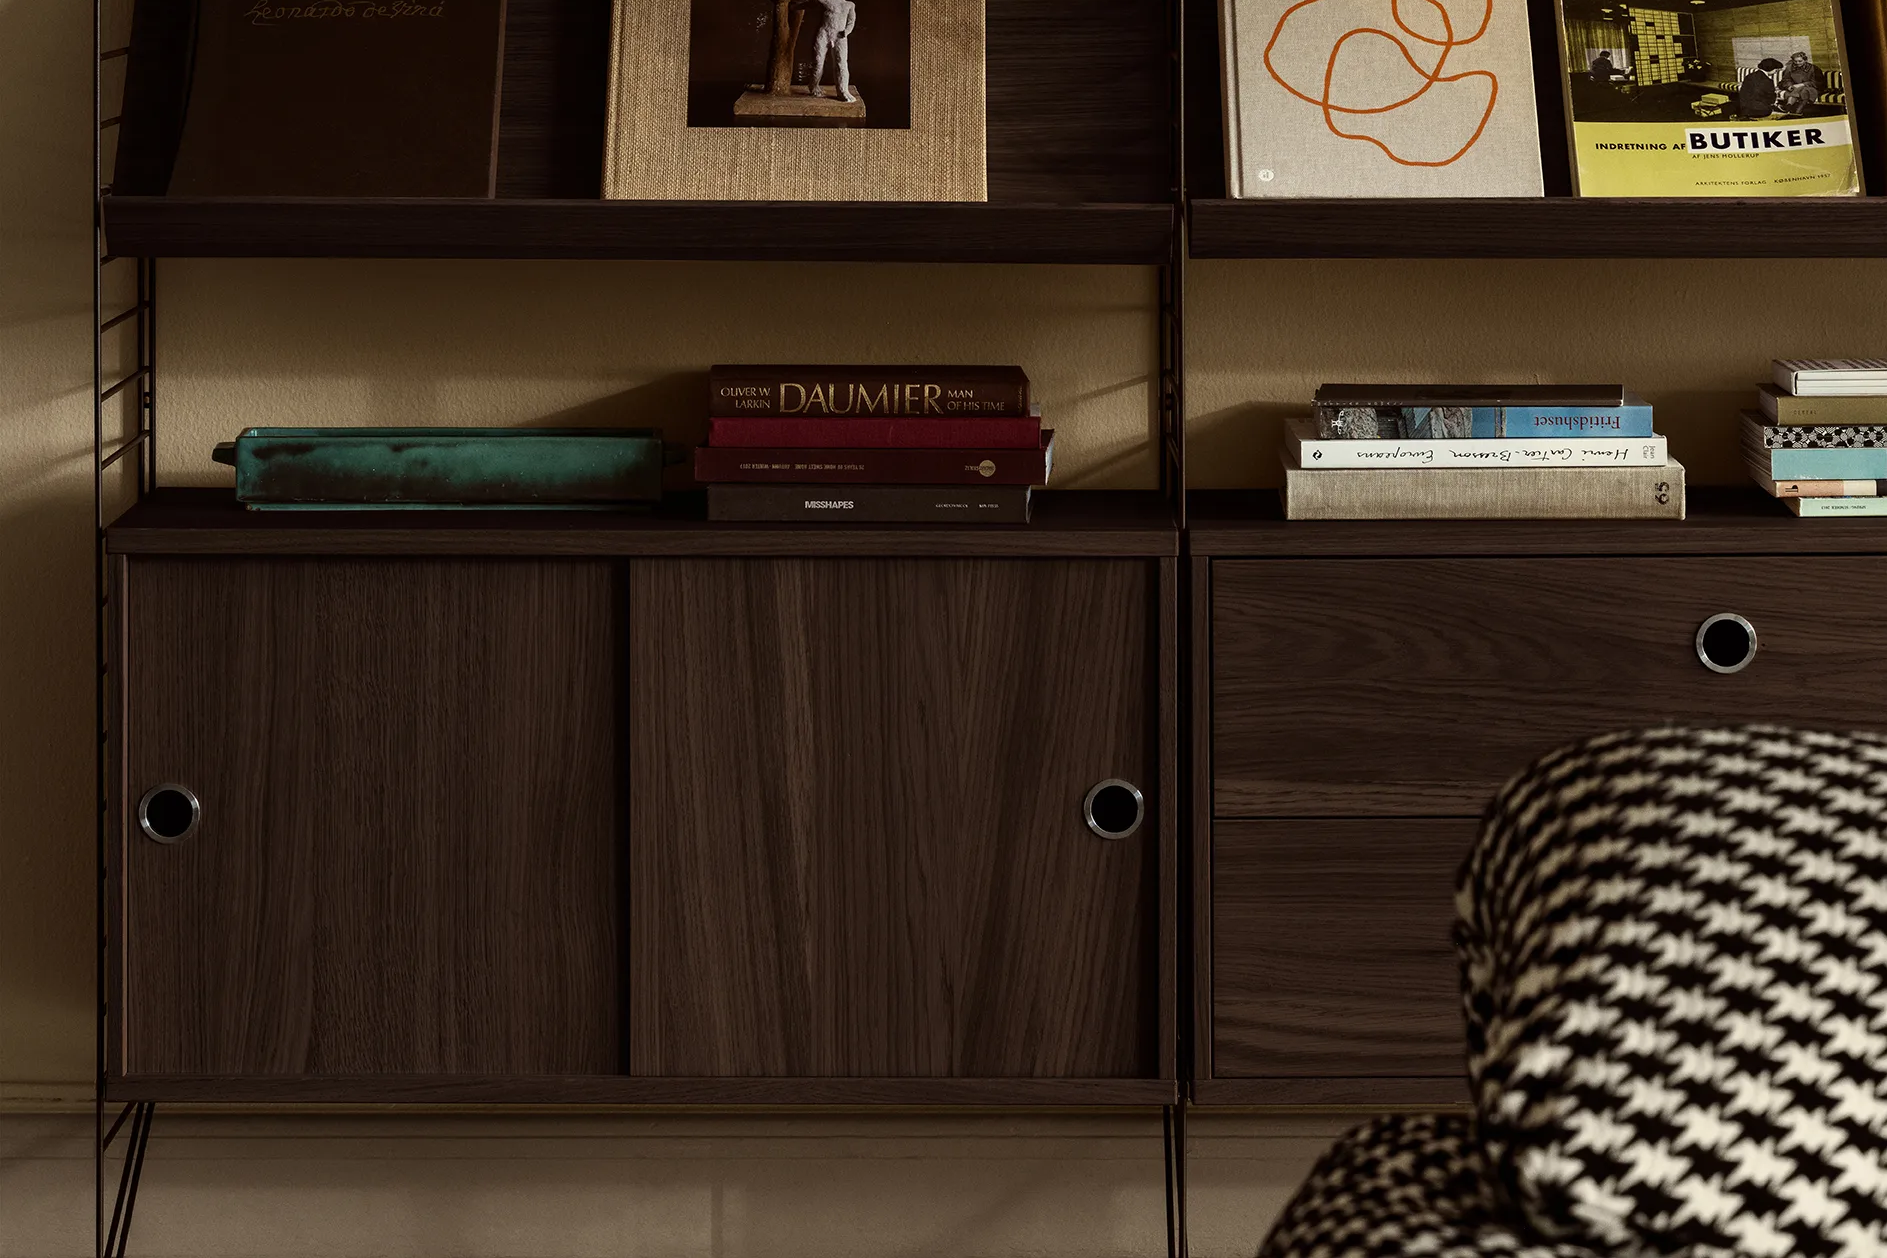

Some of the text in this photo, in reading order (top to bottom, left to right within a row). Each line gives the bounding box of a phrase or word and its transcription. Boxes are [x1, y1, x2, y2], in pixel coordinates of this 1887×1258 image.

[1595, 128, 1826, 151] INDRETNING AF BUTIKER
[1774, 175, 1815, 184] KØBENHAVN
[720, 387, 770, 397] OLIVER W
[946, 389, 973, 399] MAN
[734, 399, 770, 409] LARKIN
[779, 383, 944, 415] DAUMIER
[946, 401, 1005, 412] OF HIS TIME
[1535, 415, 1621, 431] Fritidshuset
[1357, 447, 1629, 464] Henri Cartier-Bresson Europeans
[804, 500, 854, 510] MISSHAPES
